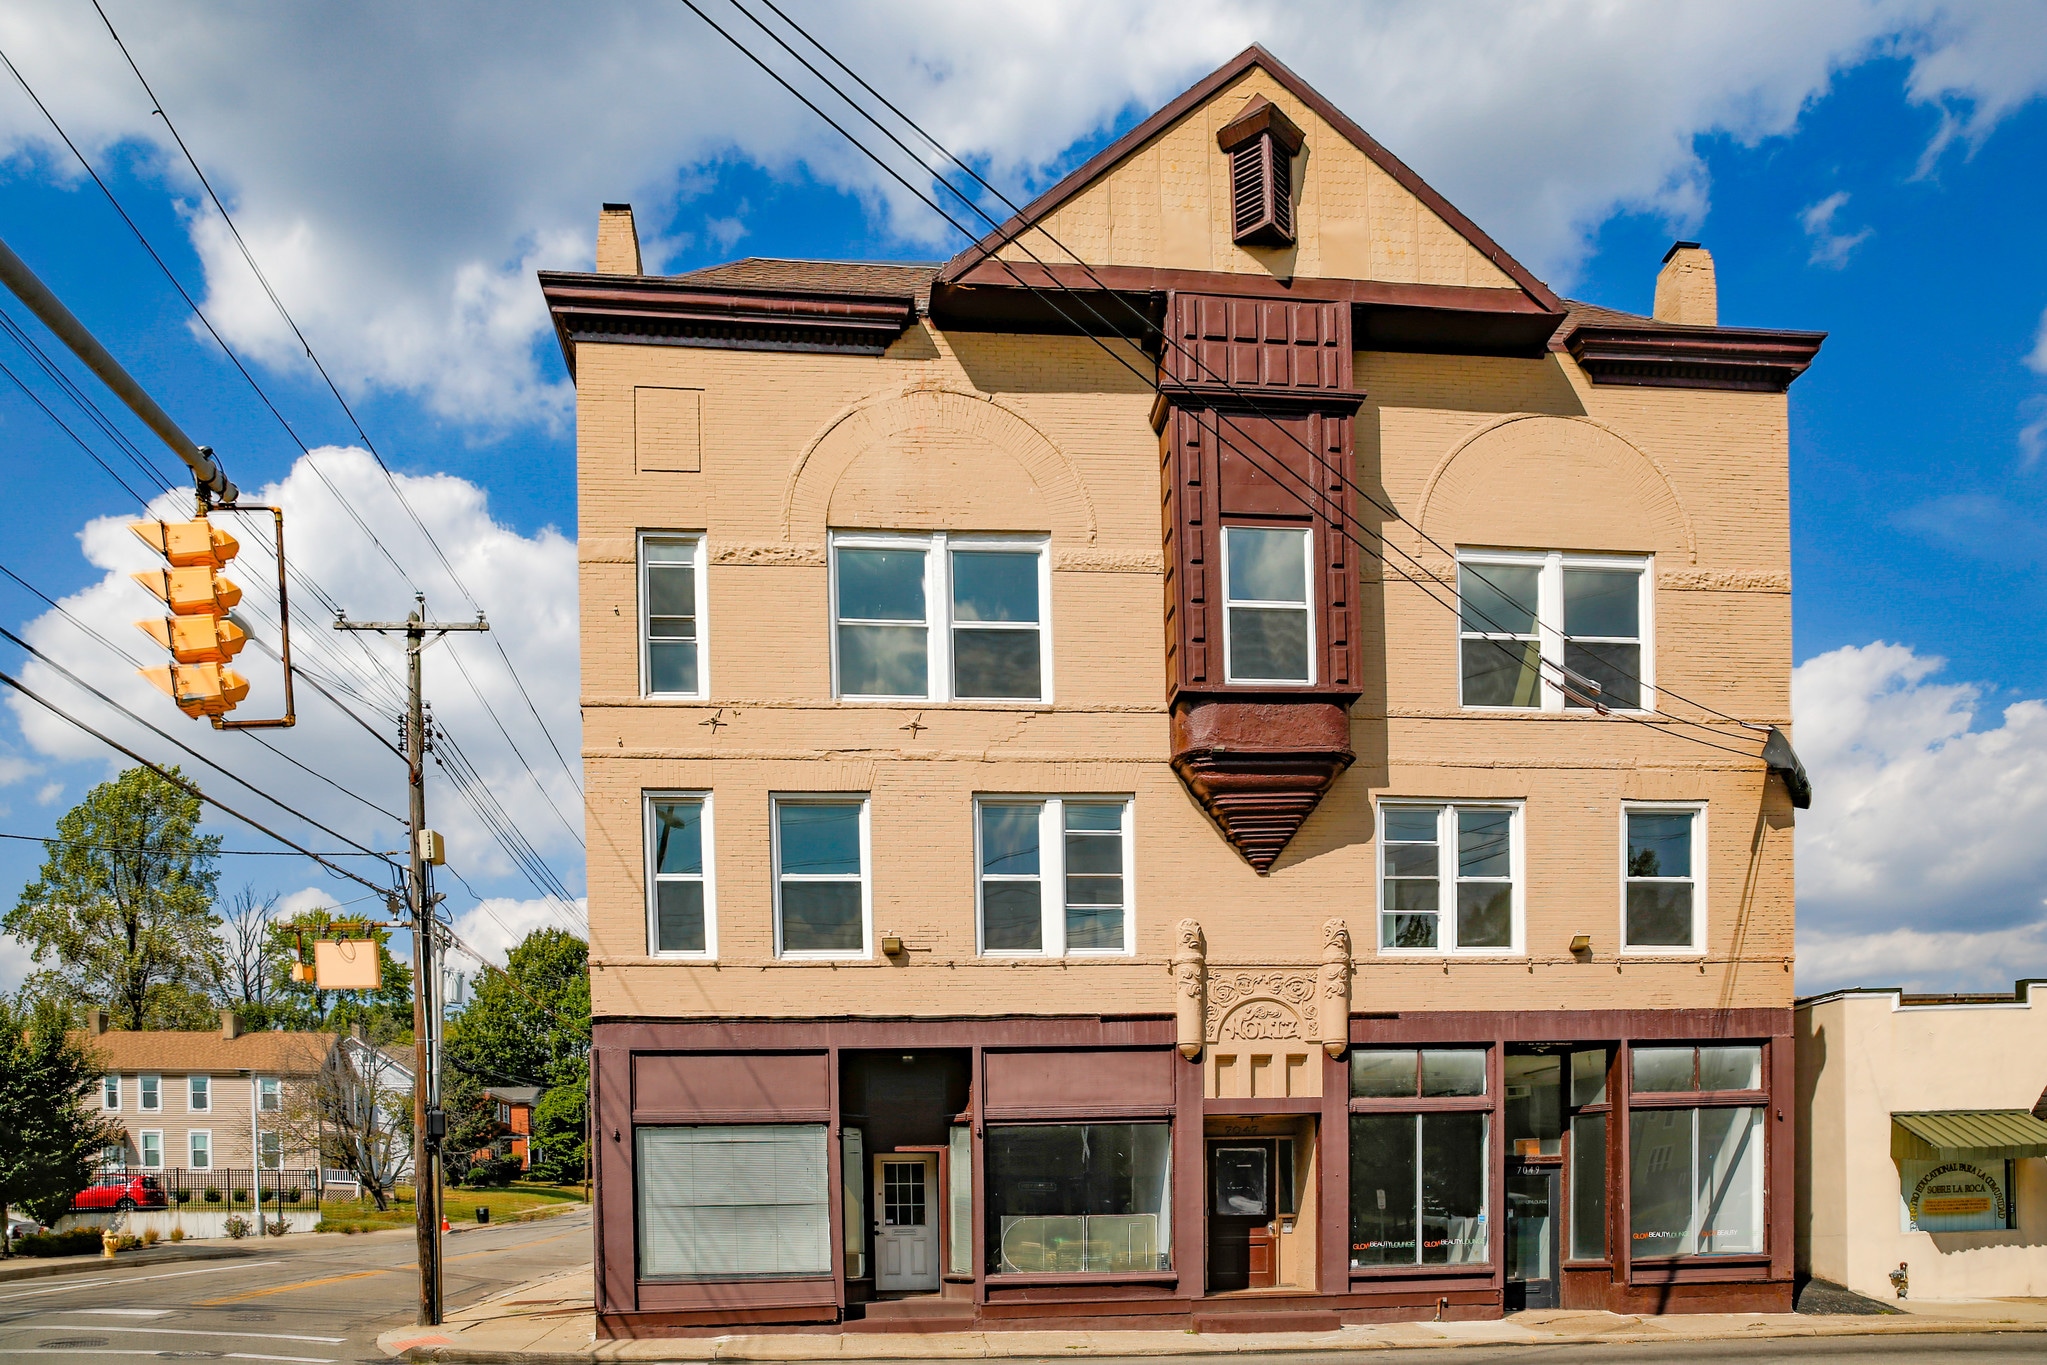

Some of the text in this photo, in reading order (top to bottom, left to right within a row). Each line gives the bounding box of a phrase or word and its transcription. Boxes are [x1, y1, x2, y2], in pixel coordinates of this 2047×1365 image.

[1516, 1165, 1540, 1175] 7049
[1915, 1163, 1958, 1194] EDUCATIONAL
[1959, 1163, 1976, 1175] PARA
[1977, 1168, 1986, 1181] LA
[1985, 1176, 2005, 1219] COMUNIDAD
[1926, 1184, 1986, 1194] SOBRE LA ROCA
